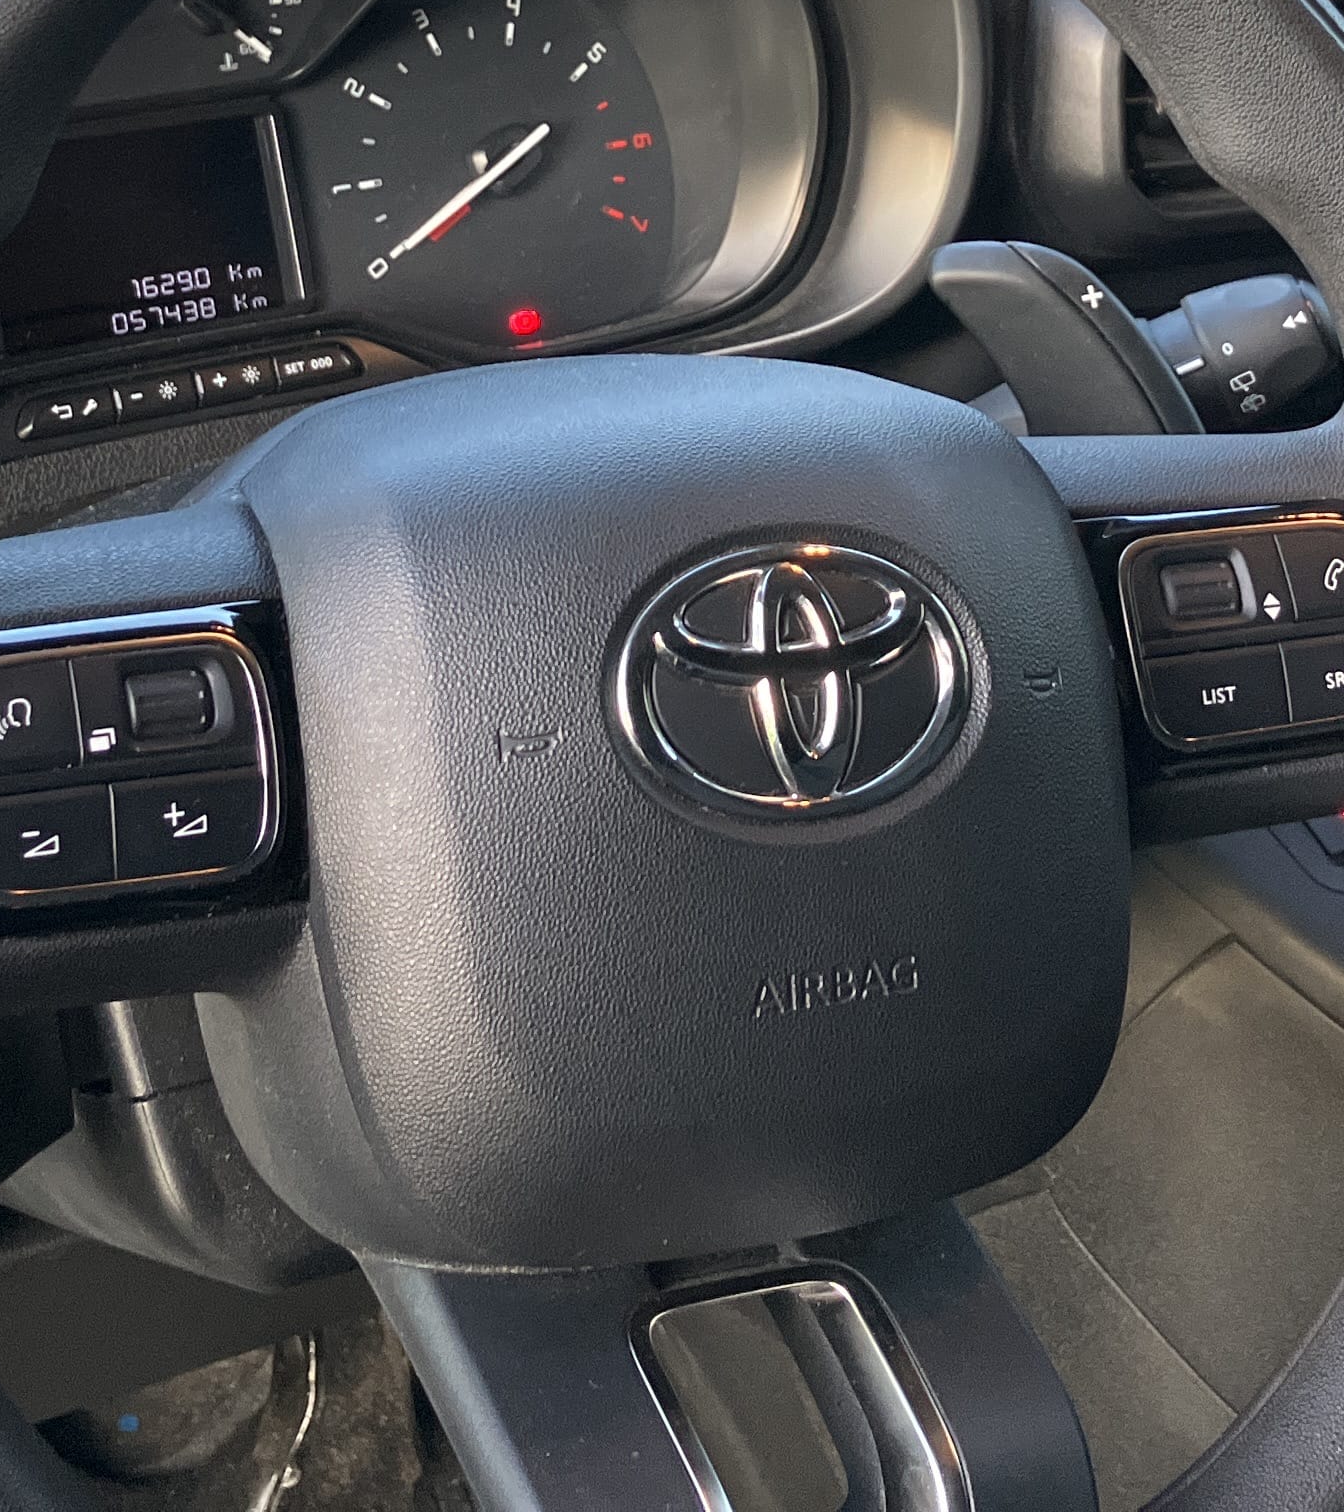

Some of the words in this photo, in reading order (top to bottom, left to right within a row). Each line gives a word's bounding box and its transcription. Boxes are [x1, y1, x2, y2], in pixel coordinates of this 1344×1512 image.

[411, 7, 431, 33] 3
[584, 41, 608, 67] 5
[343, 76, 367, 103] 2
[631, 131, 652, 150] 6
[332, 182, 352, 196] 1
[630, 214, 649, 234] 7
[227, 262, 264, 283] Km
[366, 257, 390, 281] 0
[110, 296, 217, 336] 057438
[232, 291, 269, 313] Km
[283, 359, 305, 376] SET
[1201, 685, 1237, 707] LIST
[753, 954, 922, 1020] AIRBAG
